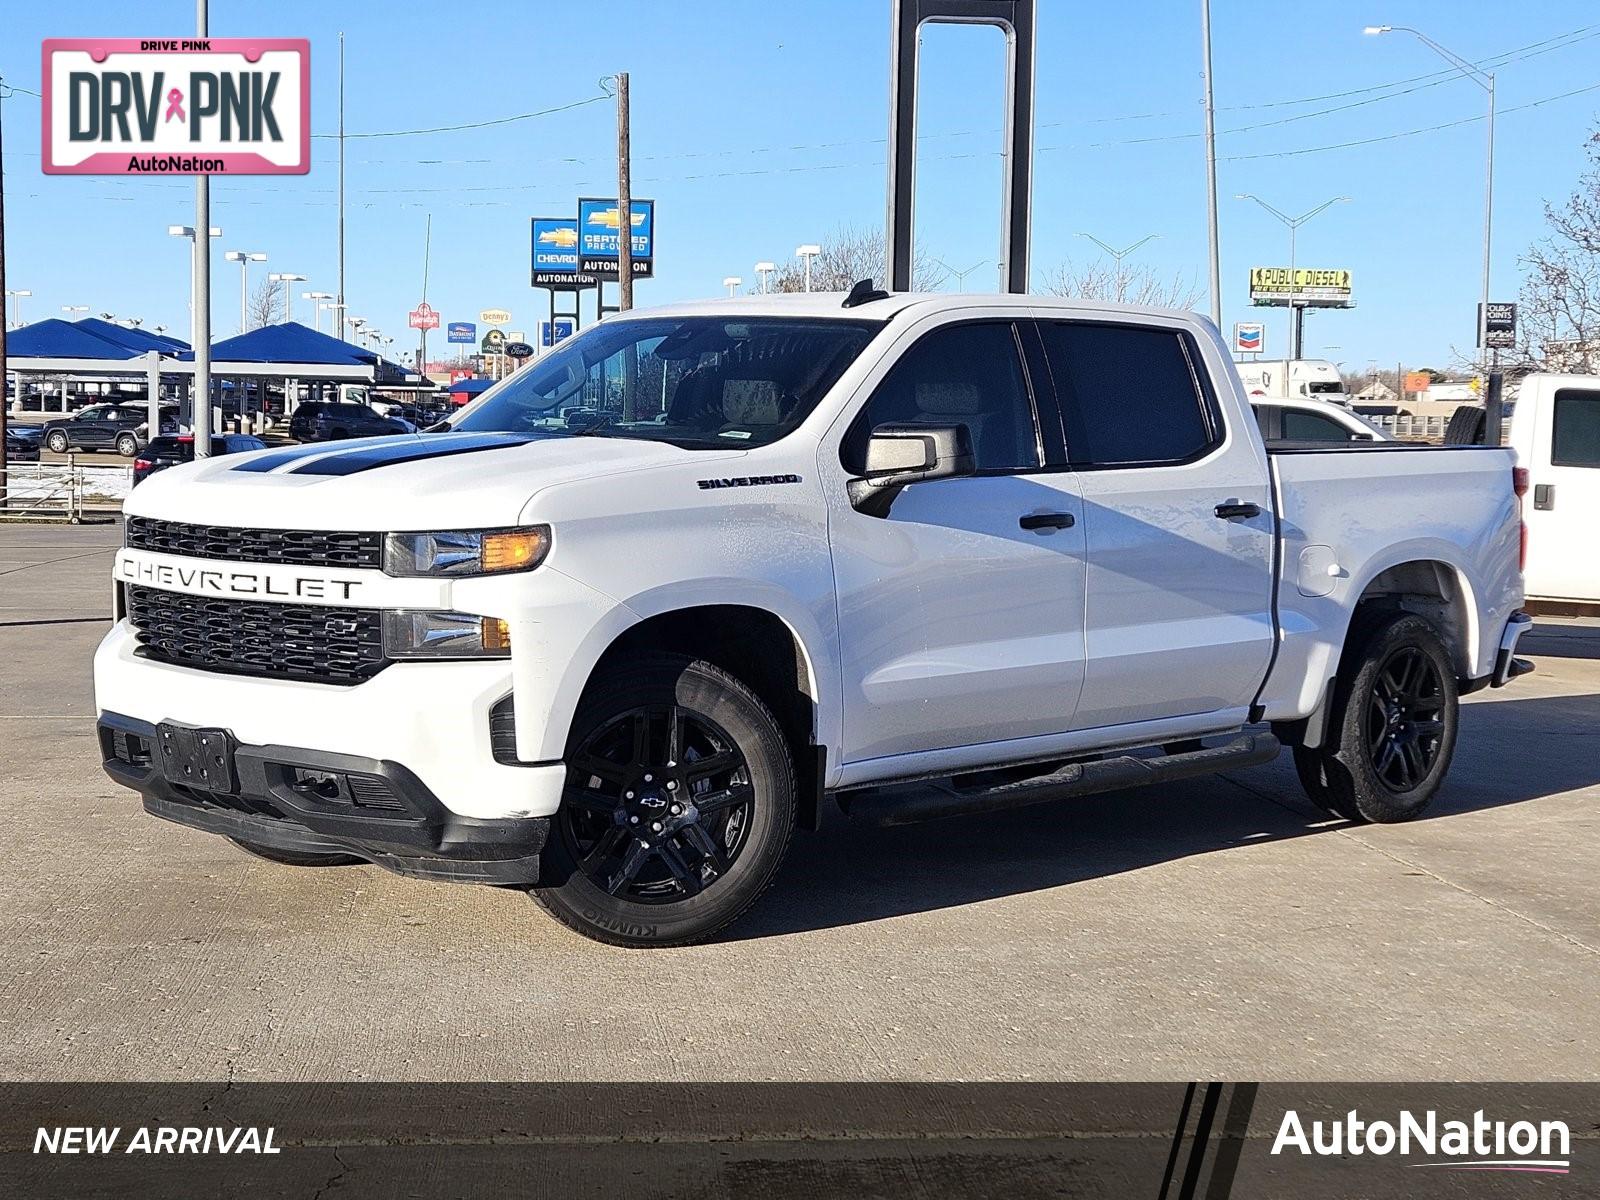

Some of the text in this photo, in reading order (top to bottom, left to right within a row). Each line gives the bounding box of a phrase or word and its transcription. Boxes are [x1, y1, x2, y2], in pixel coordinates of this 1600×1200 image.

[583, 260, 648, 272] AUTONON
[536, 273, 594, 283] AUTONATION
[1264, 269, 1340, 286] PUBLIC DIESEL
[696, 474, 802, 490] SILVERADO
[121, 559, 362, 600] CHEVROLET
